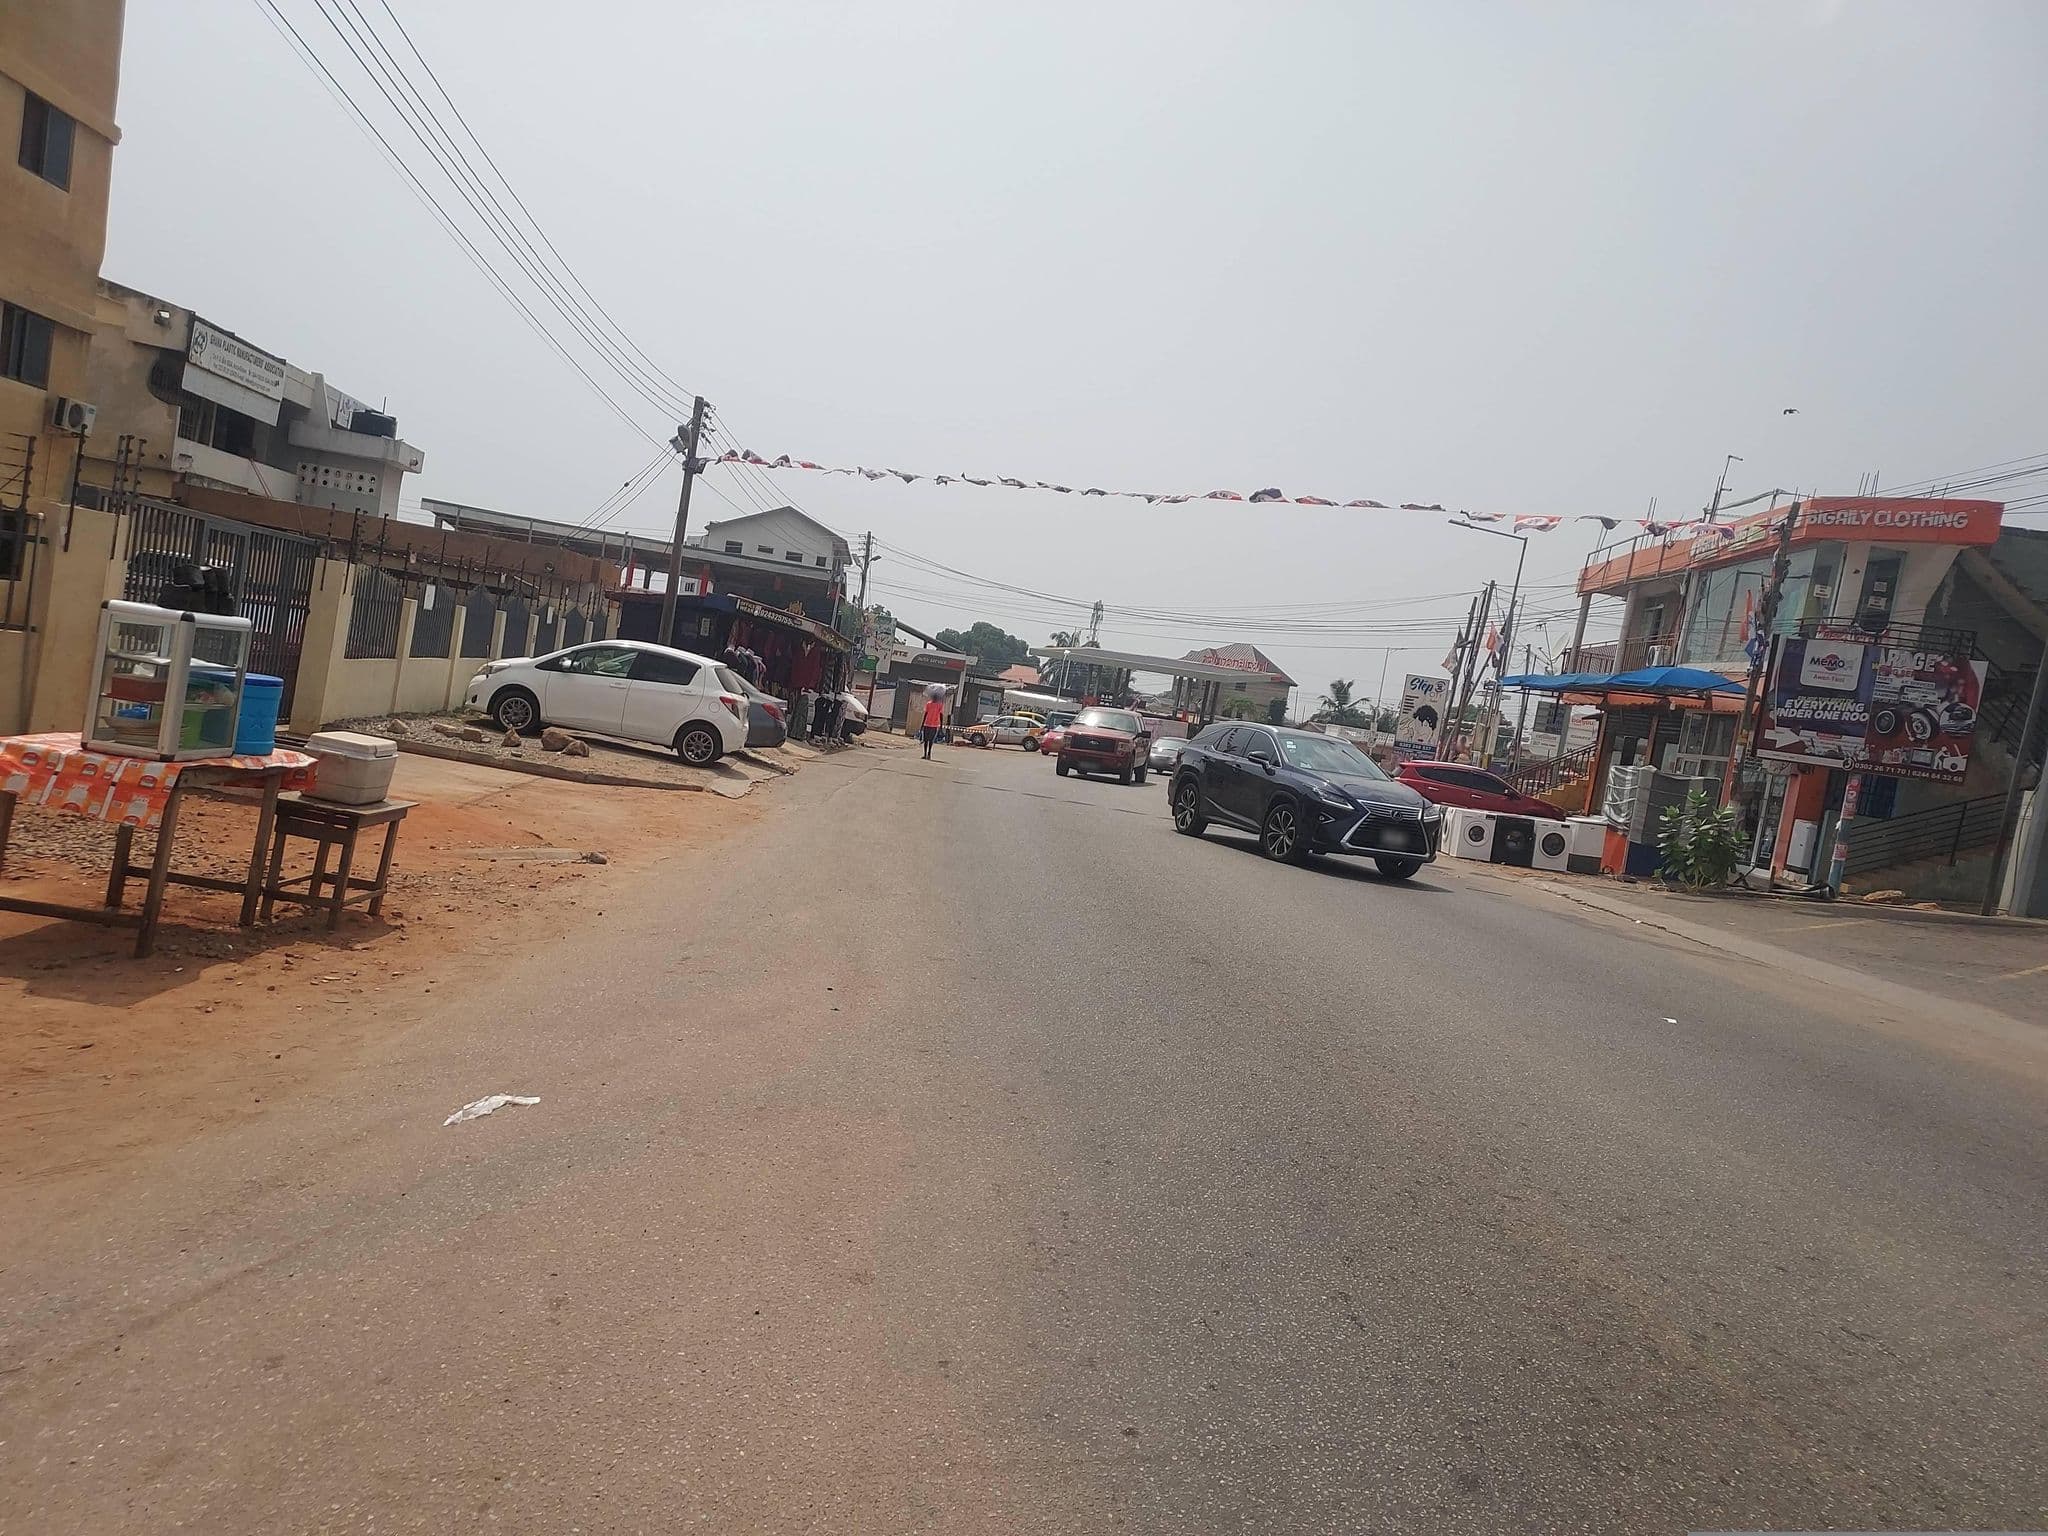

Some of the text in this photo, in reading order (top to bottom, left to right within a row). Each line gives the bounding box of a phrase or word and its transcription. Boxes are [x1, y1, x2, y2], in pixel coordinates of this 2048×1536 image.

[1874, 510, 1969, 529] CLOTHING
[1410, 677, 1434, 695] Step
[1785, 699, 1865, 712] EVERYTHING
[1814, 709, 1840, 720] ONE
